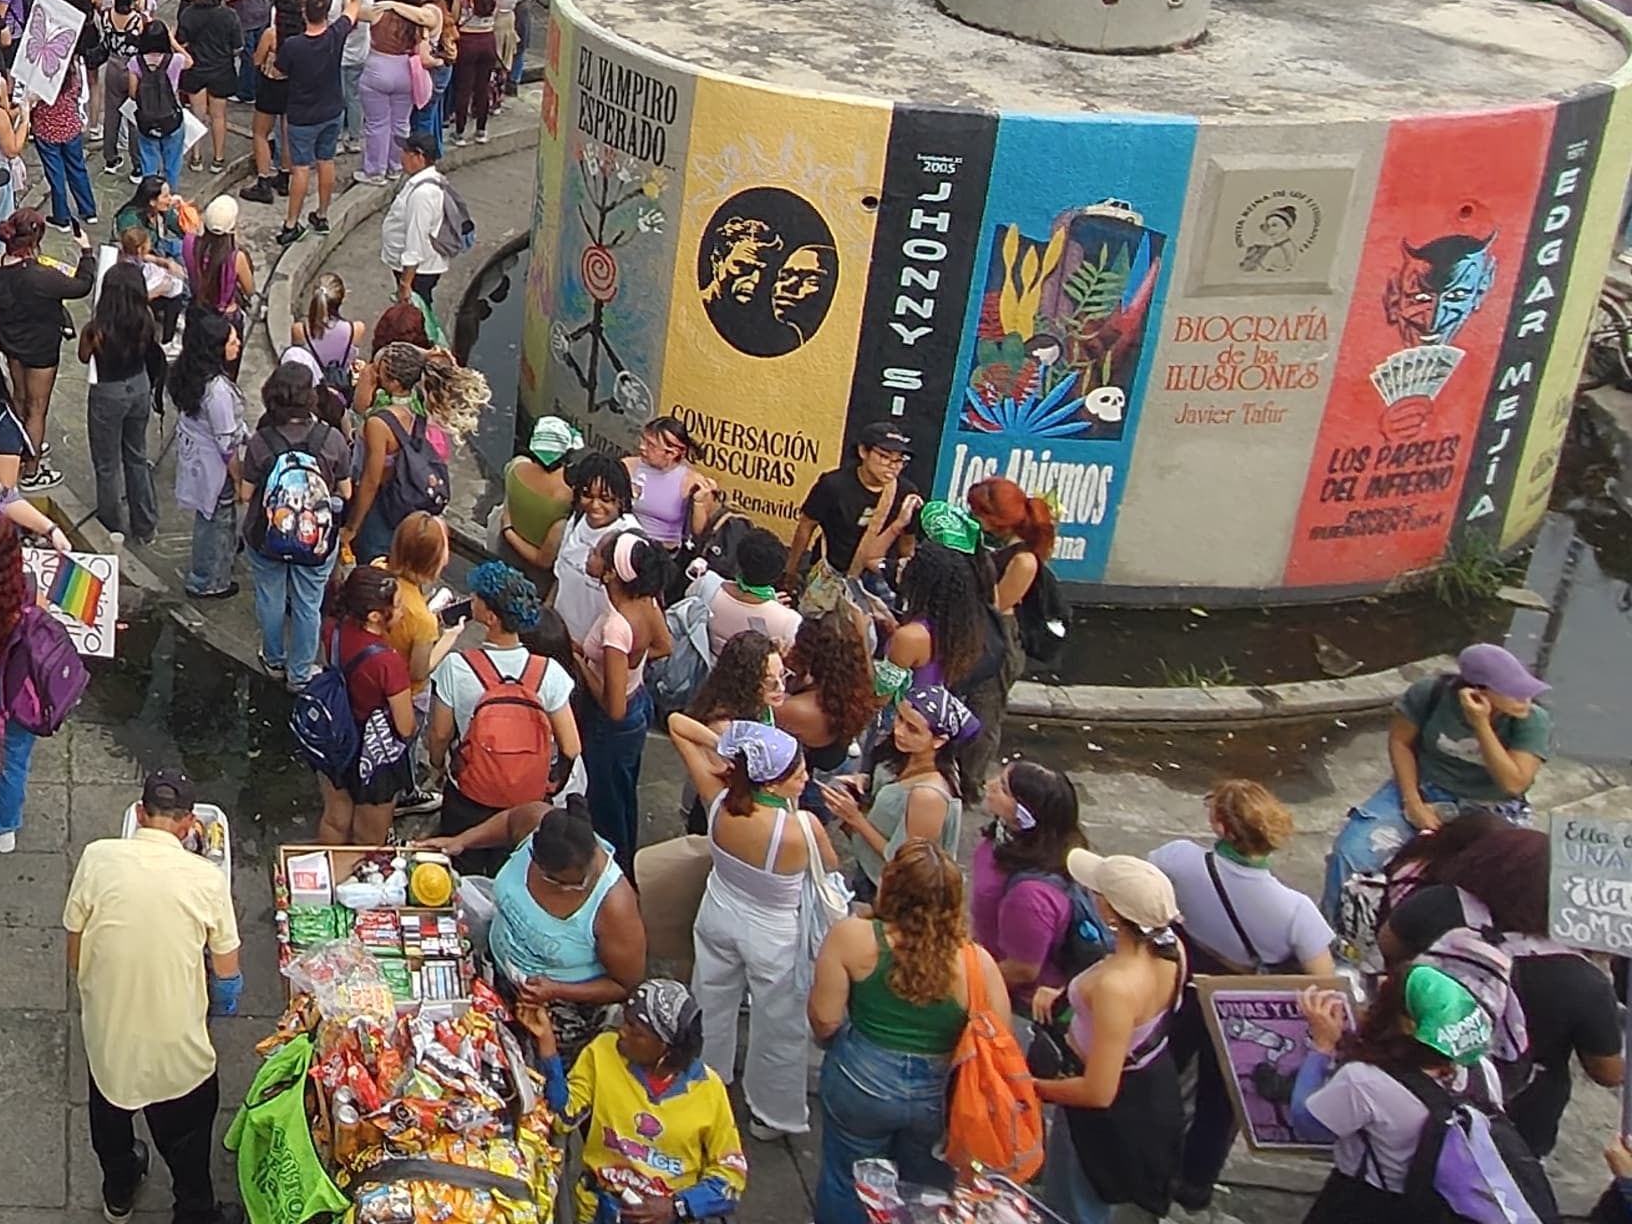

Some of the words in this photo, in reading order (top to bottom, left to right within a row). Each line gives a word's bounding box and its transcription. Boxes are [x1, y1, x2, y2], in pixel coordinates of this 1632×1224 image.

[578, 46, 593, 91] EL
[599, 56, 677, 125] VAMPIRO
[923, 161, 956, 174] 2005
[888, 181, 953, 346] JHONNY
[1517, 168, 1581, 338] EDGAR
[1174, 306, 1328, 343] BIOGRAFÍA
[1218, 343, 1246, 365] de
[1254, 344, 1279, 365] las
[1164, 362, 1321, 392] ILUSIONES
[1175, 402, 1236, 425] Javier
[1242, 400, 1288, 425] Tafur
[671, 404, 821, 464] CONVERSACIÓN
[1328, 445, 1371, 474] LOS
[1374, 434, 1461, 471] PAPELES
[1320, 476, 1359, 503] DEL
[1364, 465, 1455, 501] INFIERNO
[732, 489, 801, 521] Benavide
[1564, 820, 1610, 844] Ella
[1562, 842, 1626, 871] UNA
[1569, 877, 1628, 911] Ella
[1217, 1001, 1269, 1019] VIVAS
[1270, 1002, 1282, 1018] Y
